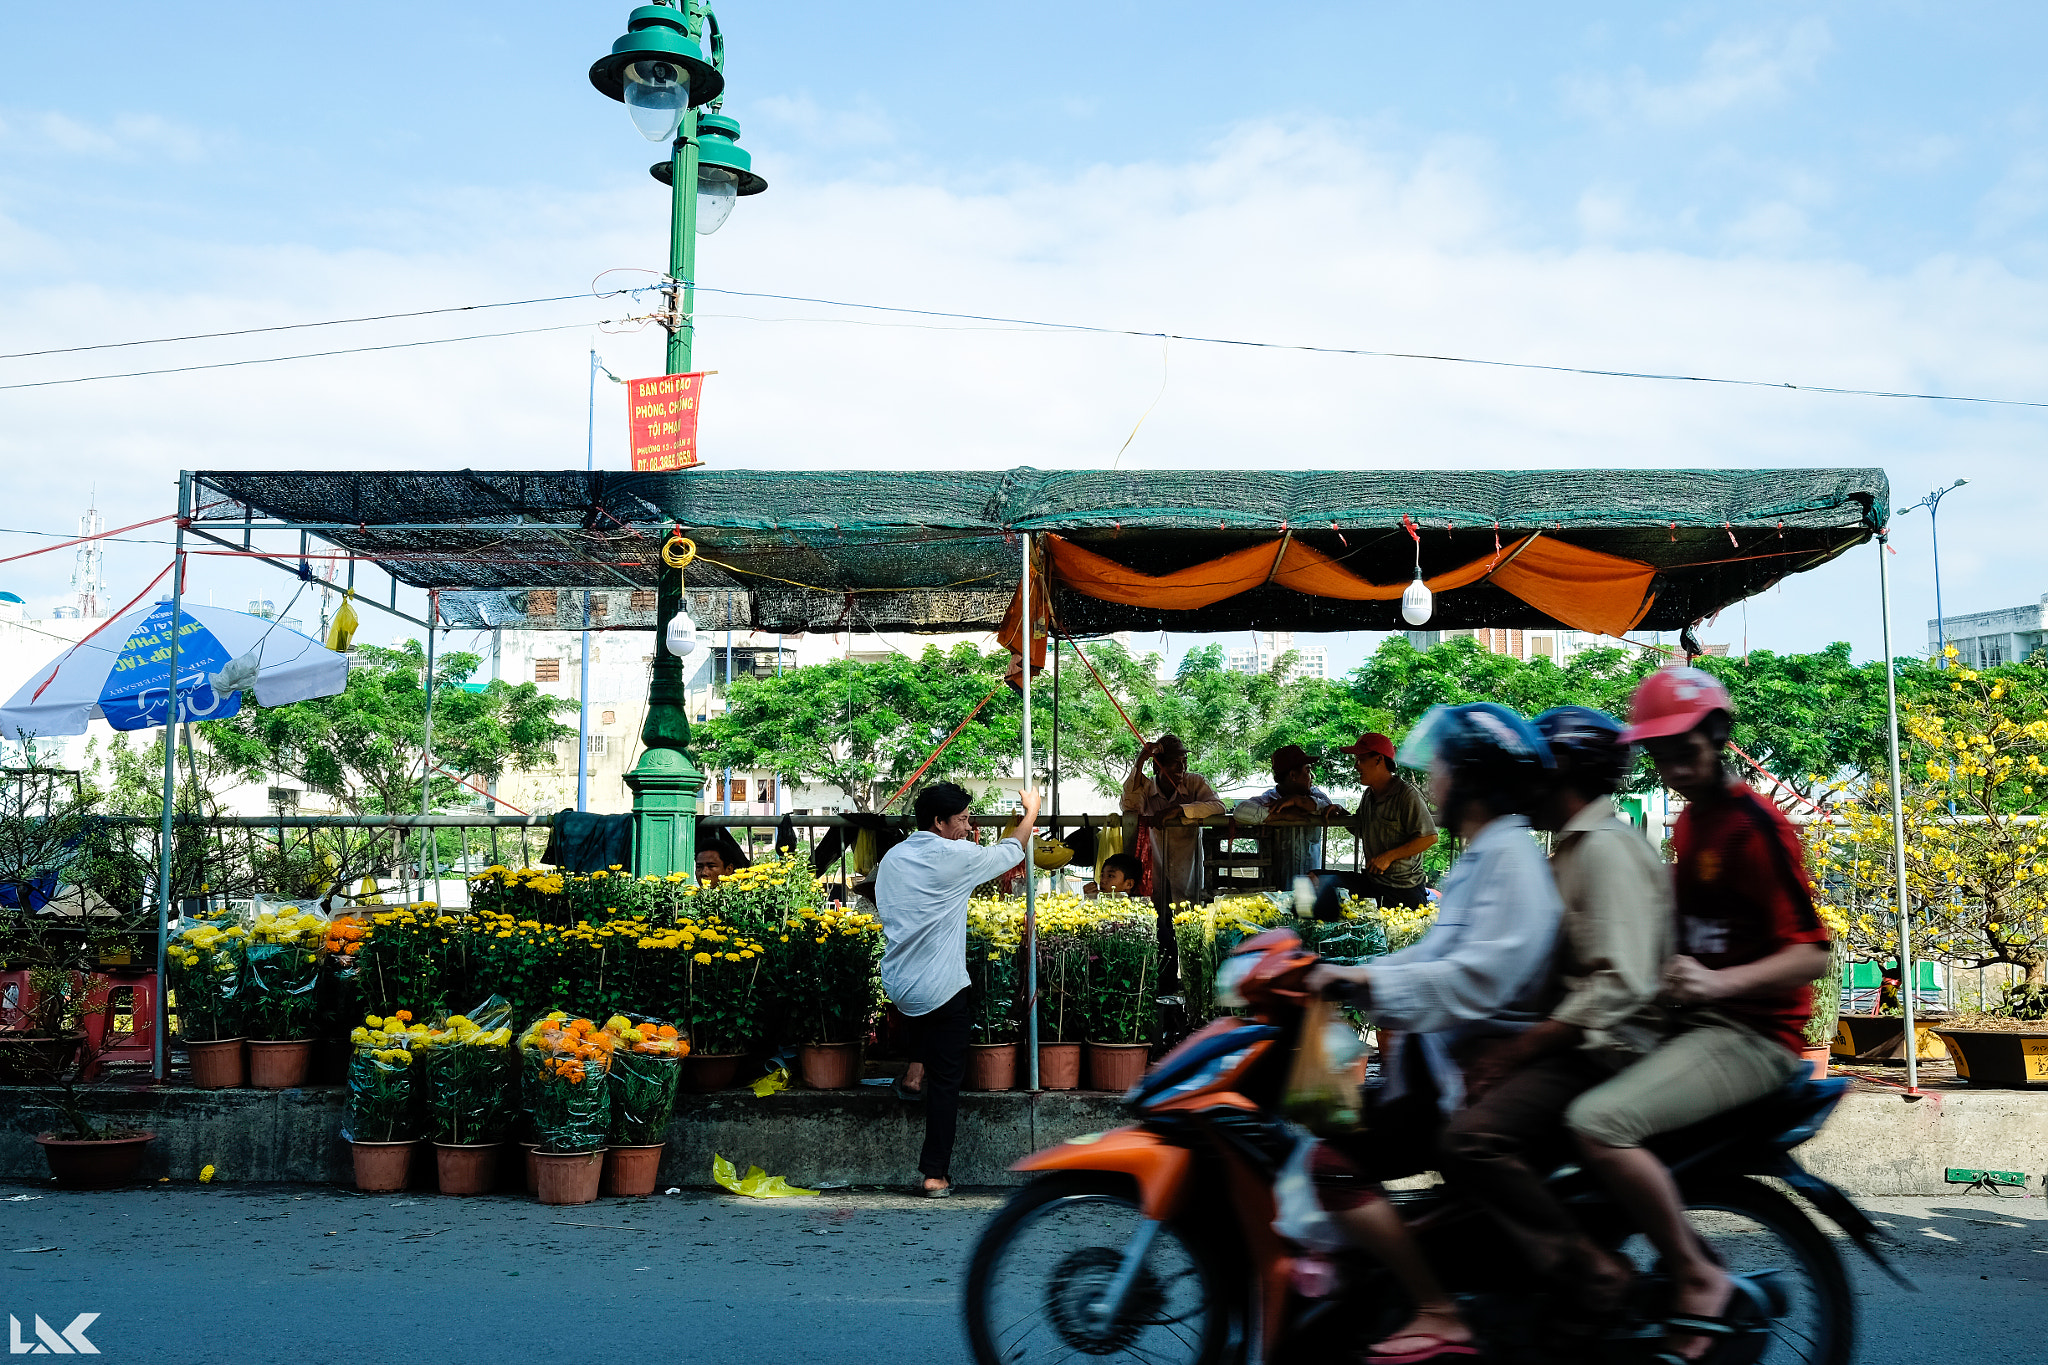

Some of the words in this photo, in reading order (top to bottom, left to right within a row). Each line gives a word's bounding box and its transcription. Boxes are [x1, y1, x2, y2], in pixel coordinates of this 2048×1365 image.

[639, 382, 658, 397] BAN
[635, 402, 667, 418] PHÒNG,
[648, 421, 661, 439] TỘI
[109, 667, 184, 696] ANIVERSARY
